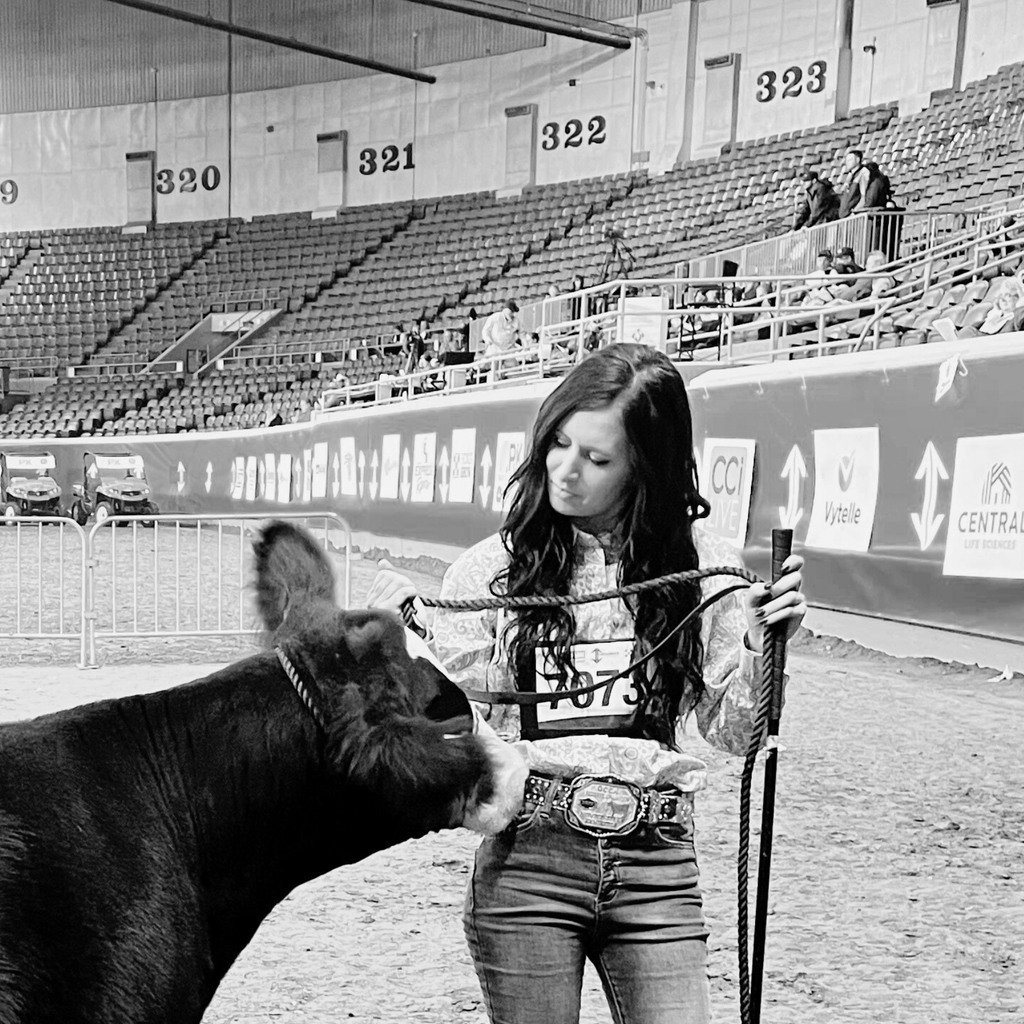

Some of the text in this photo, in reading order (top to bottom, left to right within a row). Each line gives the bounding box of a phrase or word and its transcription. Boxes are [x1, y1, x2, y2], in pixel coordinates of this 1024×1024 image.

[755, 60, 827, 103] 323
[542, 115, 606, 151] 322
[359, 142, 415, 175] 321
[156, 165, 221, 194] 320
[825, 501, 862, 526] Vytelle
[958, 511, 1024, 534] CENTRAL
